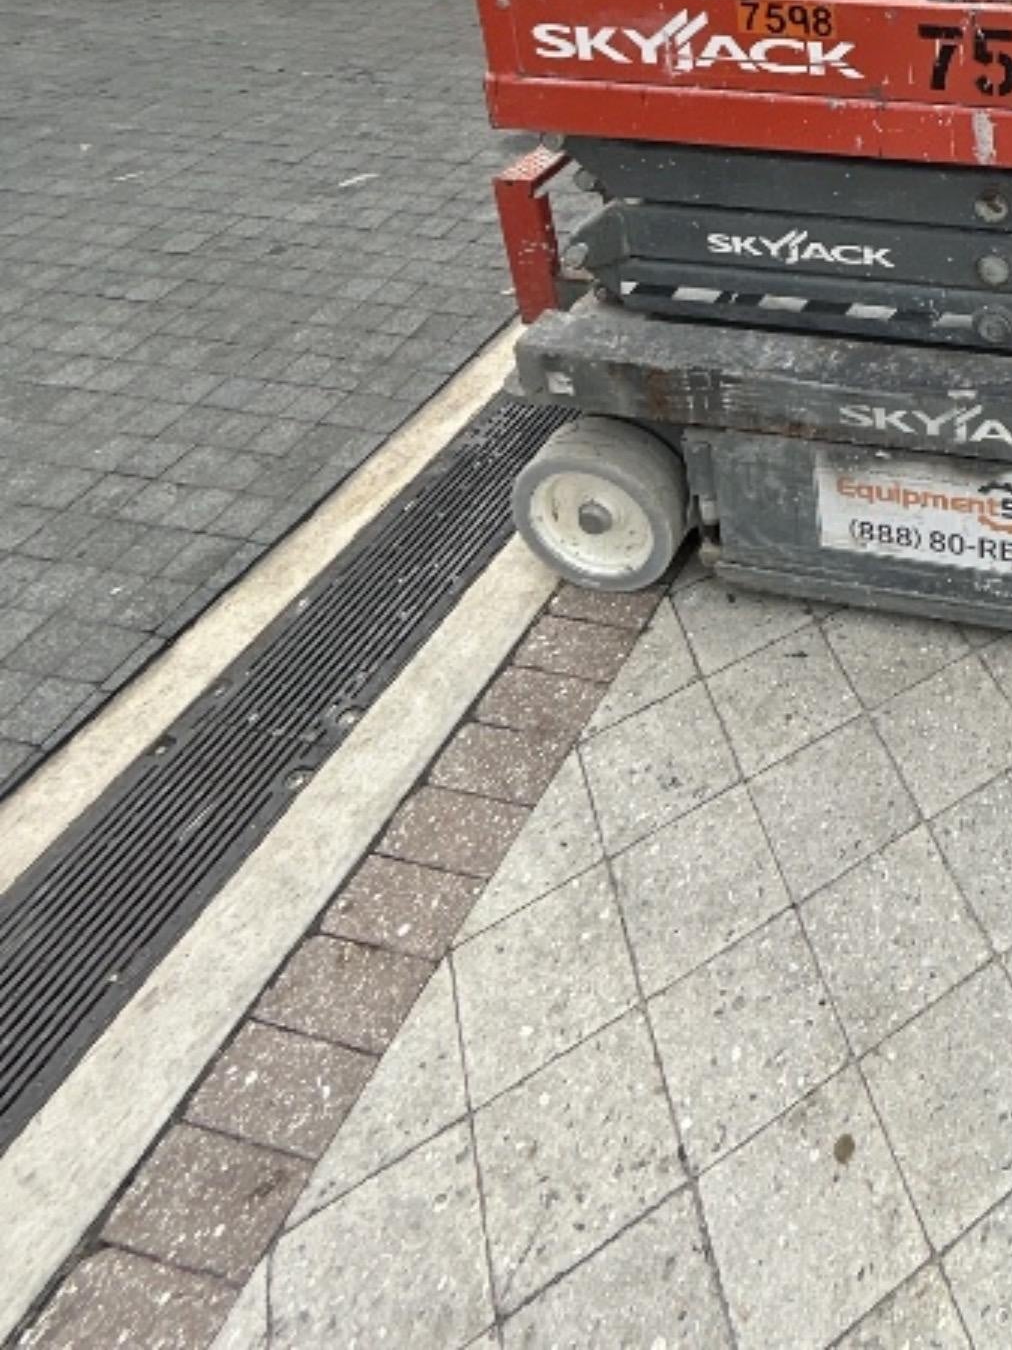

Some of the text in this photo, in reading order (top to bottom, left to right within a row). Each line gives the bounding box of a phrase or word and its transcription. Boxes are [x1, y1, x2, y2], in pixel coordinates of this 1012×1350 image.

[736, 1, 833, 37] 7598
[531, 8, 863, 79] SKYJACK
[706, 229, 895, 268] SKYJACK
[849, 518, 922, 548] (888)
